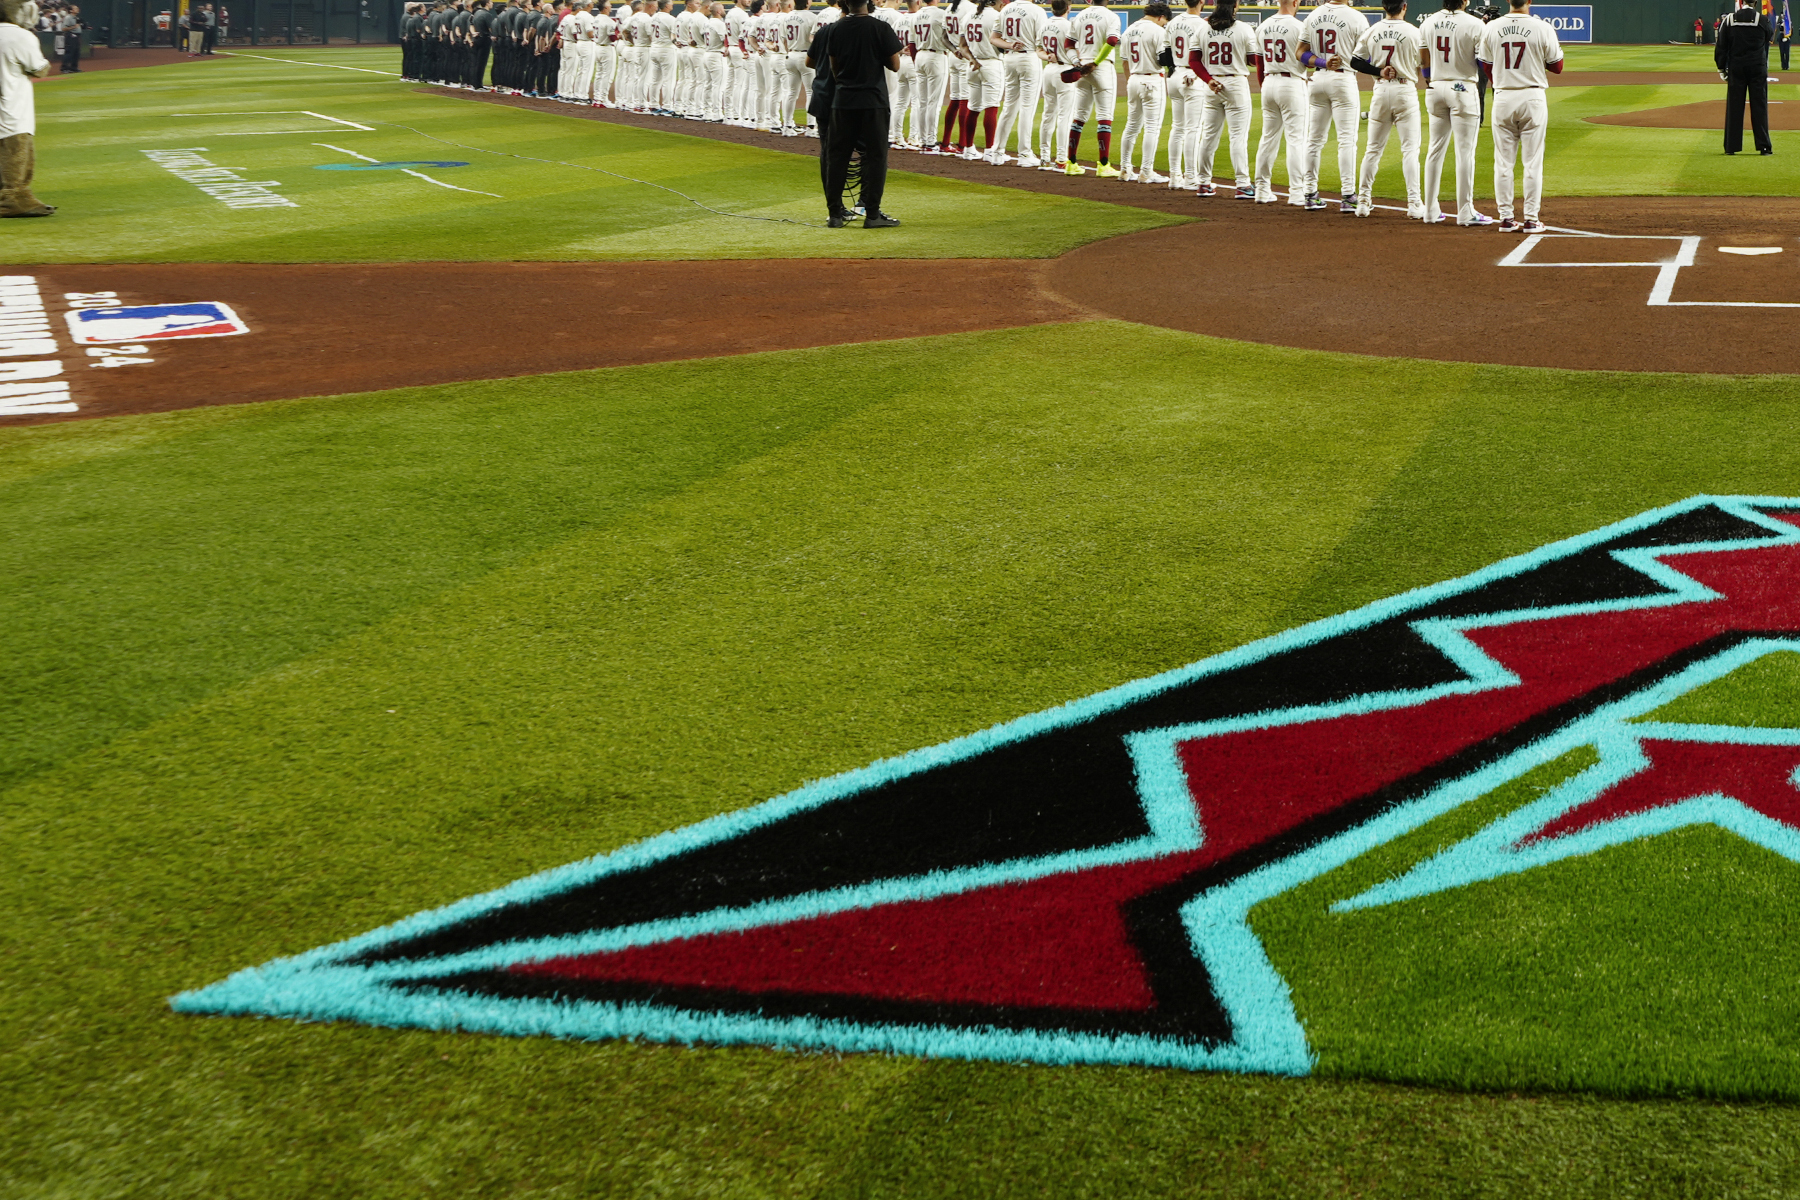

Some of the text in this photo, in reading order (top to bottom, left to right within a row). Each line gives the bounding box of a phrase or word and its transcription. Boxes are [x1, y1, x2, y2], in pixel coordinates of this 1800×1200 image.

[651, 24, 660, 39] 76
[786, 24, 799, 41] 31
[914, 23, 931, 42] 47
[946, 16, 959, 35] 50
[967, 23, 983, 43] 65
[1006, 17, 1021, 37] 81
[1085, 23, 1094, 45] 2
[1263, 26, 1289, 36] WALKER
[1434, 22, 1458, 32] MARTE
[1498, 26, 1532, 39] LOVULLO
[1316, 29, 1336, 55] 12
[1373, 30, 1407, 44] CARROLL
[1130, 41, 1139, 64] 5
[1175, 36, 1184, 59] 9
[1208, 41, 1233, 65] 28
[1263, 39, 1286, 64] 53
[1382, 45, 1395, 66] 7
[1436, 36, 1451, 63] 4
[1501, 41, 1526, 70] 17
[63, 291, 123, 309] 20
[86, 343, 155, 369] 24
